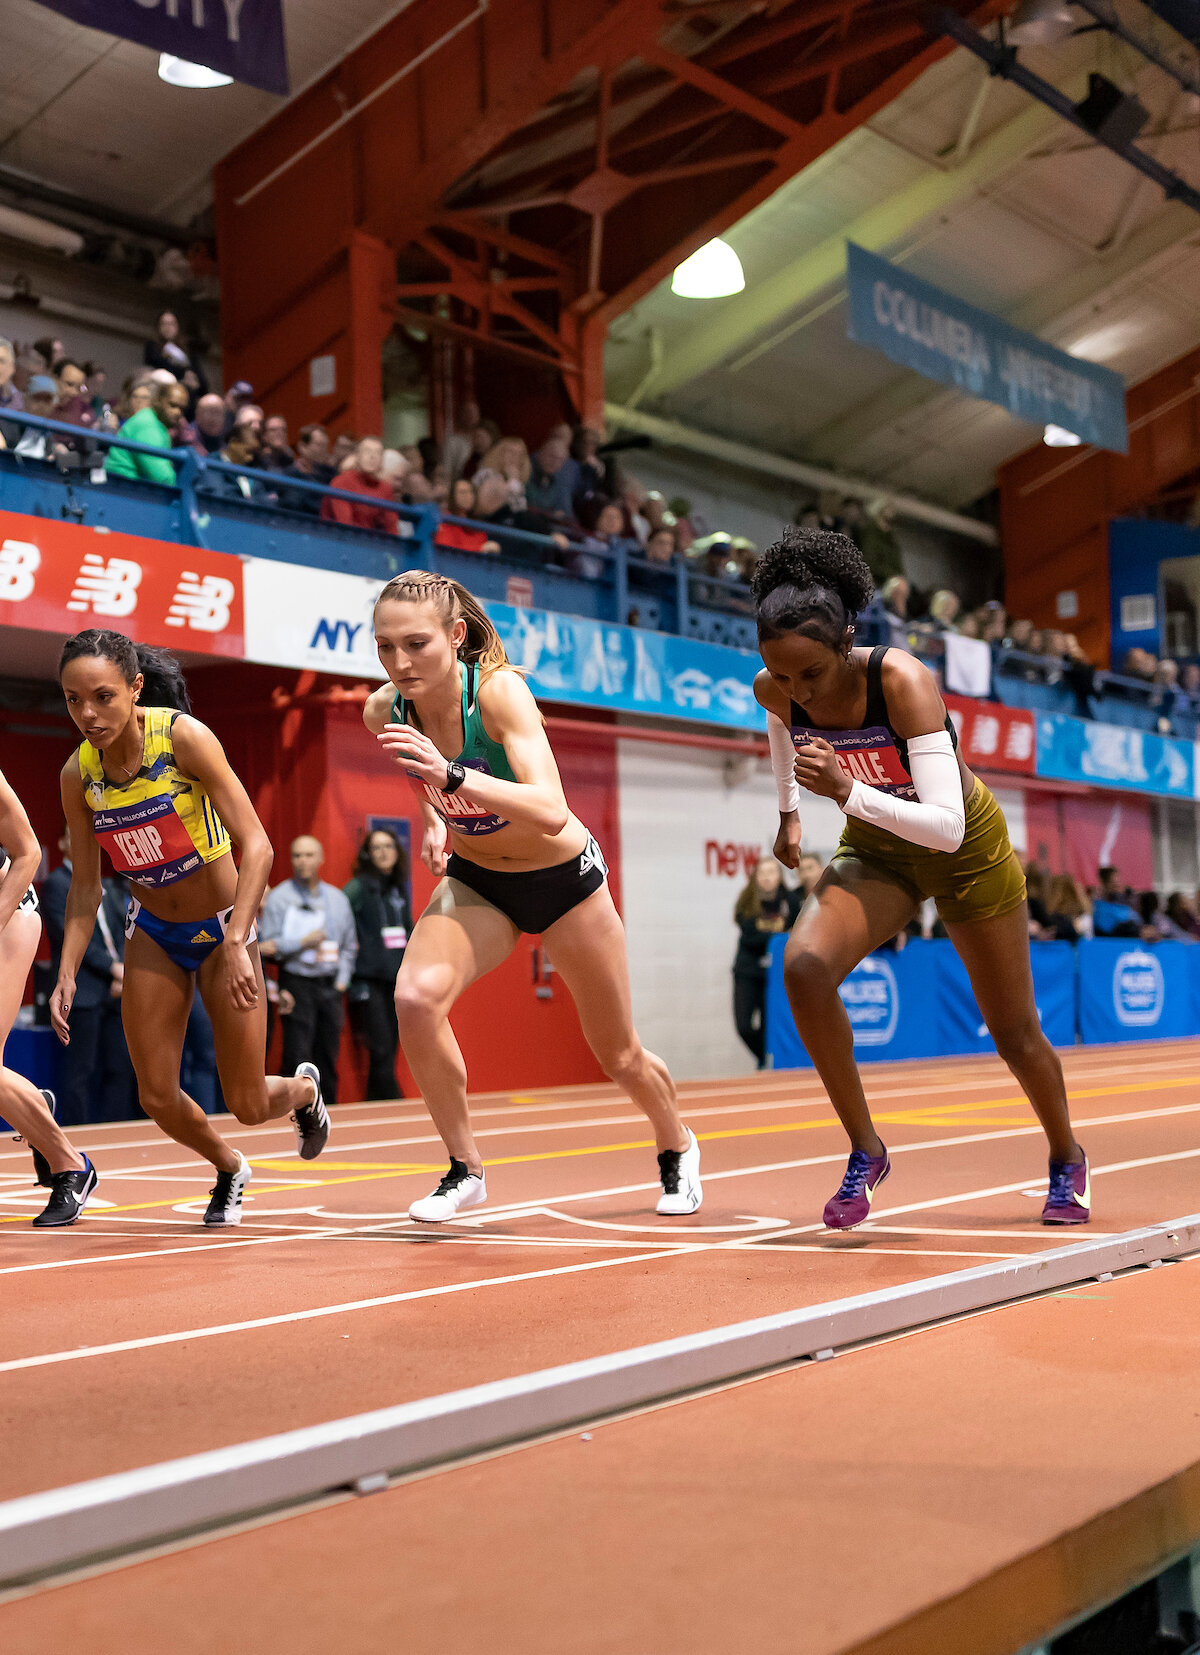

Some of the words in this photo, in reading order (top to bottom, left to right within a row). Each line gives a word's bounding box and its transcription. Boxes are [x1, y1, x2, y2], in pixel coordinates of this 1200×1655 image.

[121, 810, 148, 823] MILLROSE
[146, 803, 169, 816] GAMES
[112, 825, 165, 867] KEMP
